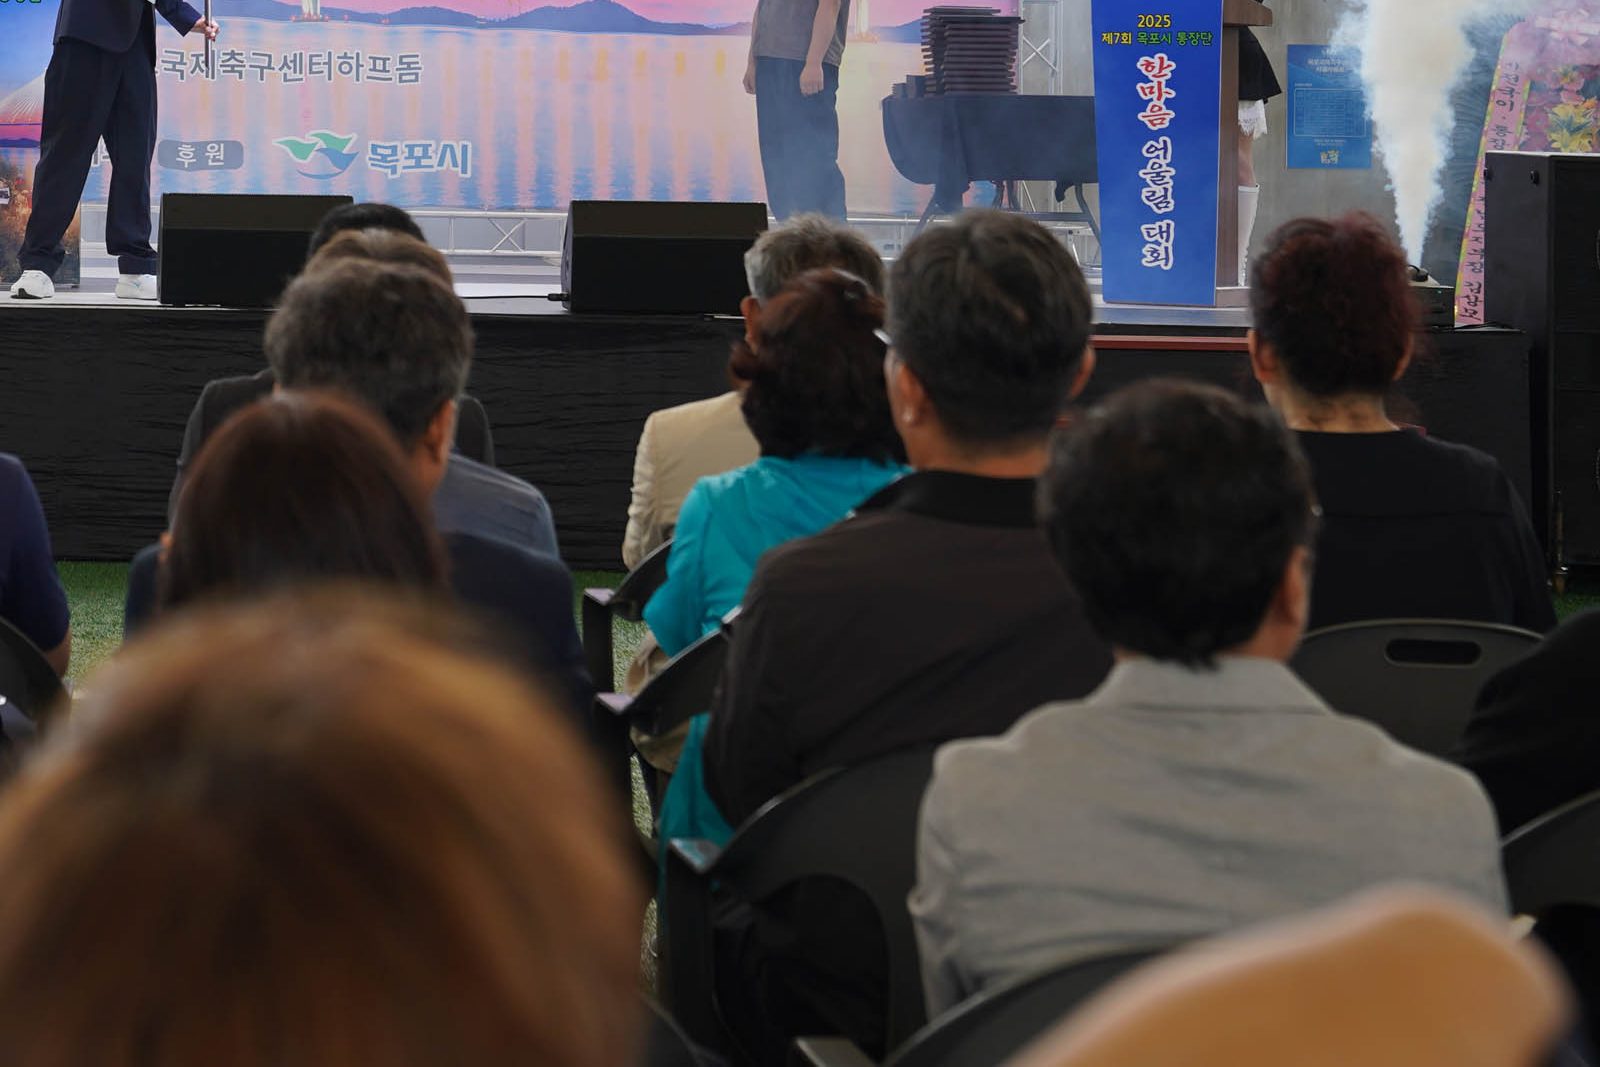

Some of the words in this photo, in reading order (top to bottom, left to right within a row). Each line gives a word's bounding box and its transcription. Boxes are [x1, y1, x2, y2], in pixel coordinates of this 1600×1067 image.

[1101, 32, 1132, 45] 제7회
[1136, 32, 1172, 46] 목포시
[1176, 32, 1213, 46] 통장단
[1137, 14, 1172, 29] 2025
[155, 48, 423, 84] 국제축구센터하프돔
[1136, 53, 1177, 131] 한마음
[368, 140, 472, 178] 목포시
[1138, 136, 1176, 214] 어울림
[1140, 219, 1175, 271] 대회
